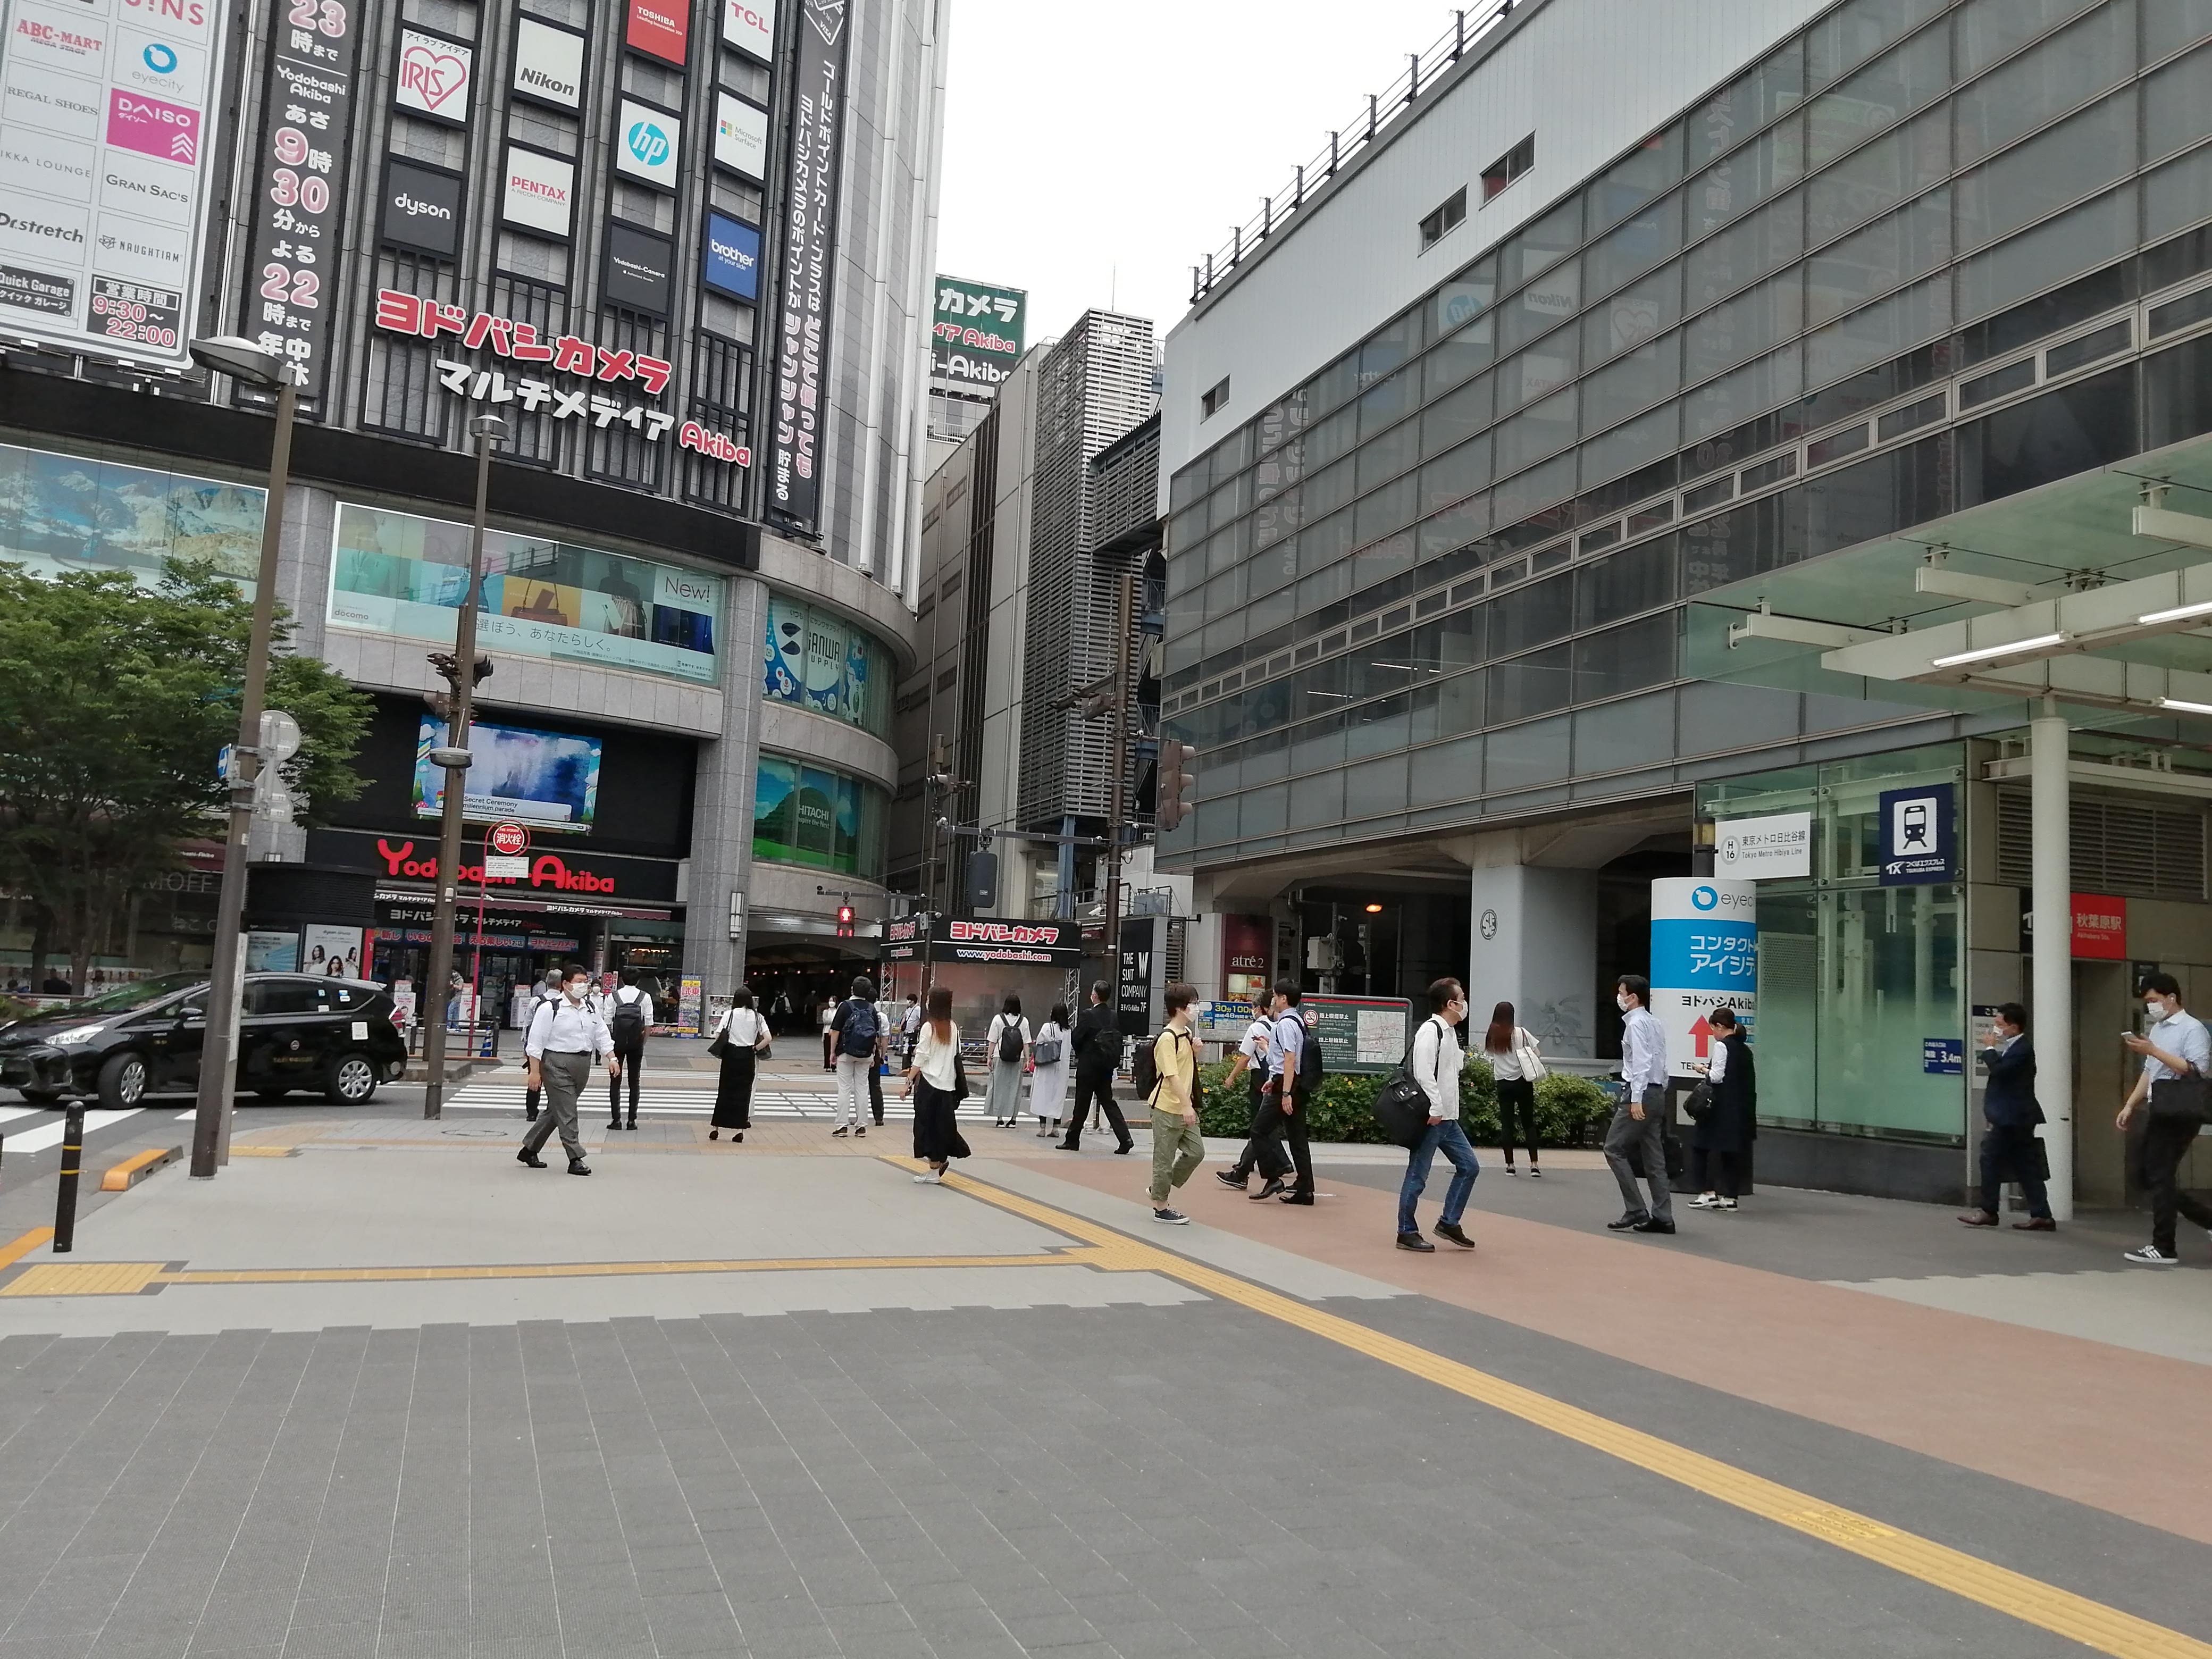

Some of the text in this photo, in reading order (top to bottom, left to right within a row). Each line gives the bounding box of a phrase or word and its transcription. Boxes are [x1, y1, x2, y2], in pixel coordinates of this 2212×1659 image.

[288, 0, 346, 38] 23
[637, 6, 675, 28] TOSHIBA
[730, 1, 769, 34] TCL
[16, 19, 102, 51] ABC-MART
[820, 20, 831, 39] VISA
[290, 29, 339, 62] 時まで
[132, 71, 185, 94] eyecity
[277, 65, 347, 96] Yodobashi
[520, 67, 575, 97] Nikon
[6, 86, 98, 115] REGAL SHOES
[290, 83, 331, 104] Akiba
[118, 112, 148, 124] ダイソー
[119, 97, 191, 128] DAISO
[285, 104, 330, 130] あさ
[633, 122, 667, 164] hp
[735, 127, 762, 145] Microsoft
[735, 134, 757, 149] Surface
[36, 158, 91, 178] LOUNGE
[270, 168, 329, 214] 30
[511, 175, 566, 202] PENTAX
[517, 189, 535, 199] RICOH
[537, 195, 566, 207] COMPANY
[395, 192, 450, 220] dyson
[273, 208, 321, 238] 分から
[272, 240, 316, 264] よる
[711, 239, 754, 267] brother
[614, 257, 665, 278] Yodobashi-Camera
[736, 263, 746, 271] side
[31, 279, 70, 298] Garage
[106, 282, 167, 307] 営業時間
[261, 263, 320, 309] 22
[35, 297, 68, 309] ガレージ
[263, 301, 312, 332] 時まで
[106, 317, 175, 347] 22:00
[374, 286, 673, 396] ヨドバシカメラ
[963, 328, 1016, 354] Akiba
[434, 357, 751, 468] マルチメディア Akiba
[665, 576, 710, 603] New!
[334, 609, 369, 620] docomo
[463, 802, 493, 811] millennium
[486, 798, 517, 808] Ceremony
[799, 805, 829, 821] HITACHI
[496, 833, 522, 845] 消火栓
[1728, 841, 1733, 849] H
[1742, 831, 1805, 846] 東京メトロ日比谷線
[1886, 861, 1905, 875] TX
[950, 921, 1059, 945] ヨドバシカメラ
[2076, 913, 2122, 931] 秋葉原駅
[957, 949, 1052, 962] www.yodobashi.com
[1123, 952, 1133, 965] THE
[1122, 968, 1134, 981] SUIT
[1121, 985, 1147, 998] COMPANY
[1141, 1002, 1147, 1013] 7F
[1940, 1051, 1962, 1063] 3.4m
